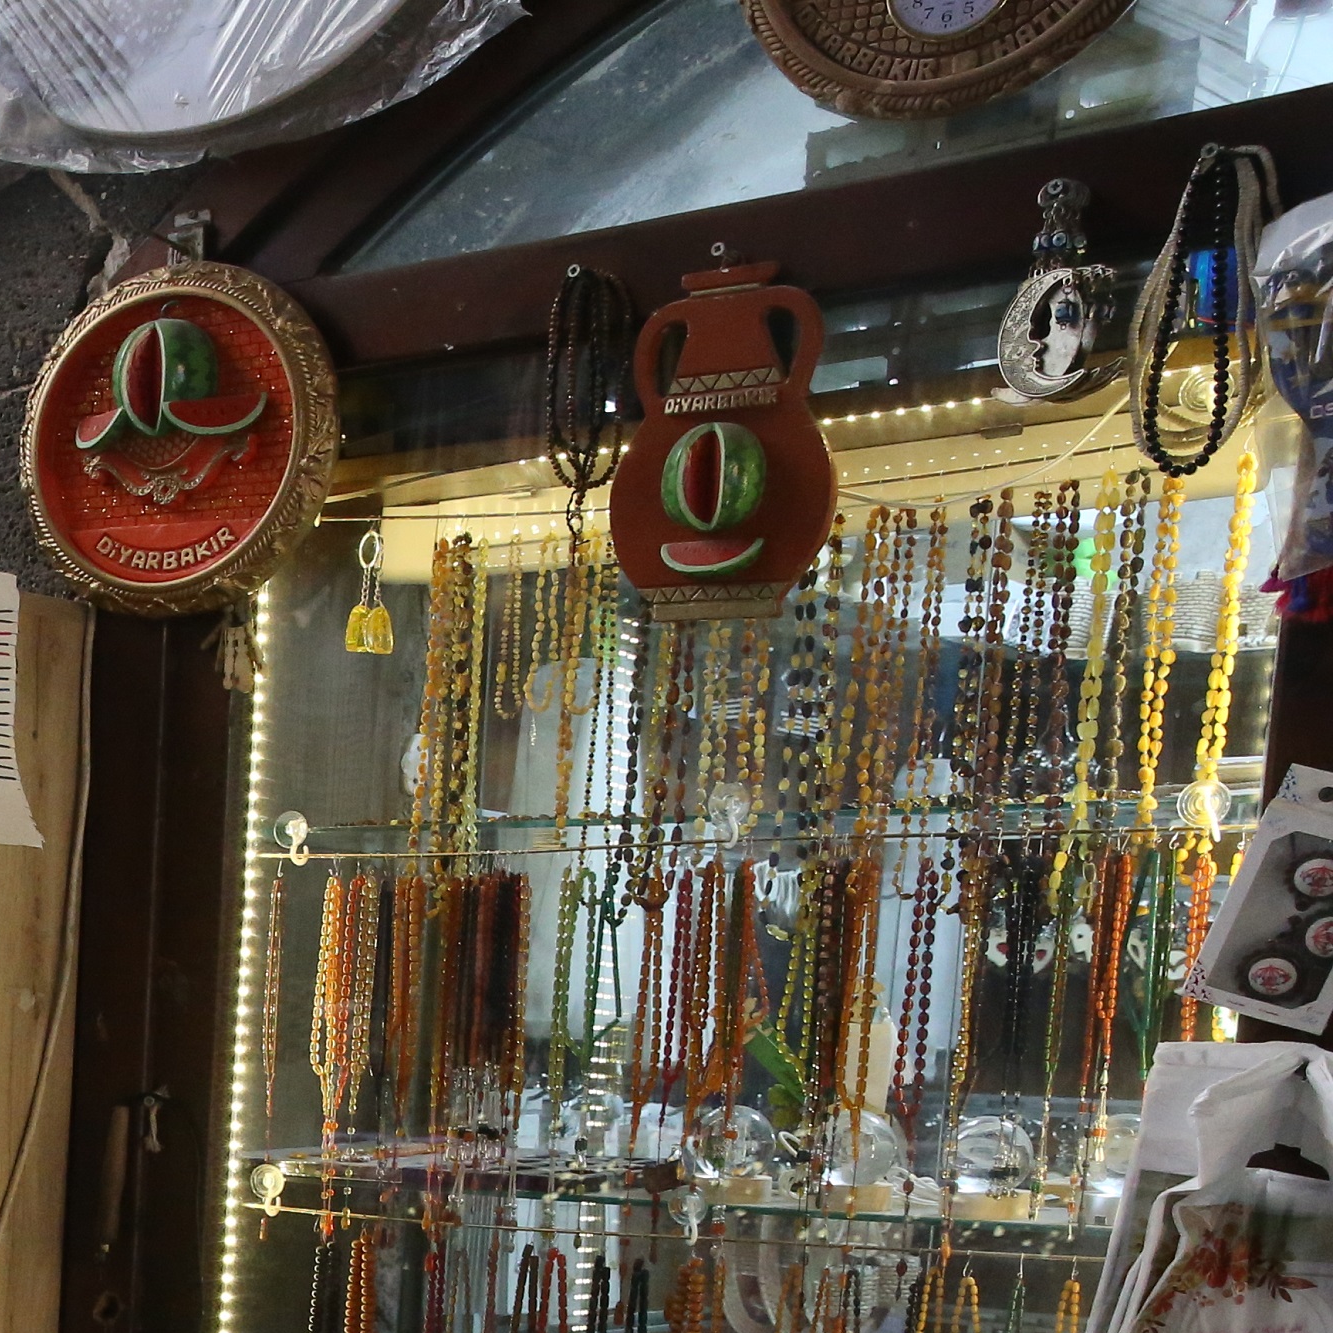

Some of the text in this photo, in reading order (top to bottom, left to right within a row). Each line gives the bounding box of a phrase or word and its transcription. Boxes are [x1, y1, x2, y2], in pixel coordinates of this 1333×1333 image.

[924, 7, 935, 20] 7
[963, 1, 975, 14] 5
[940, 10, 953, 23] 6
